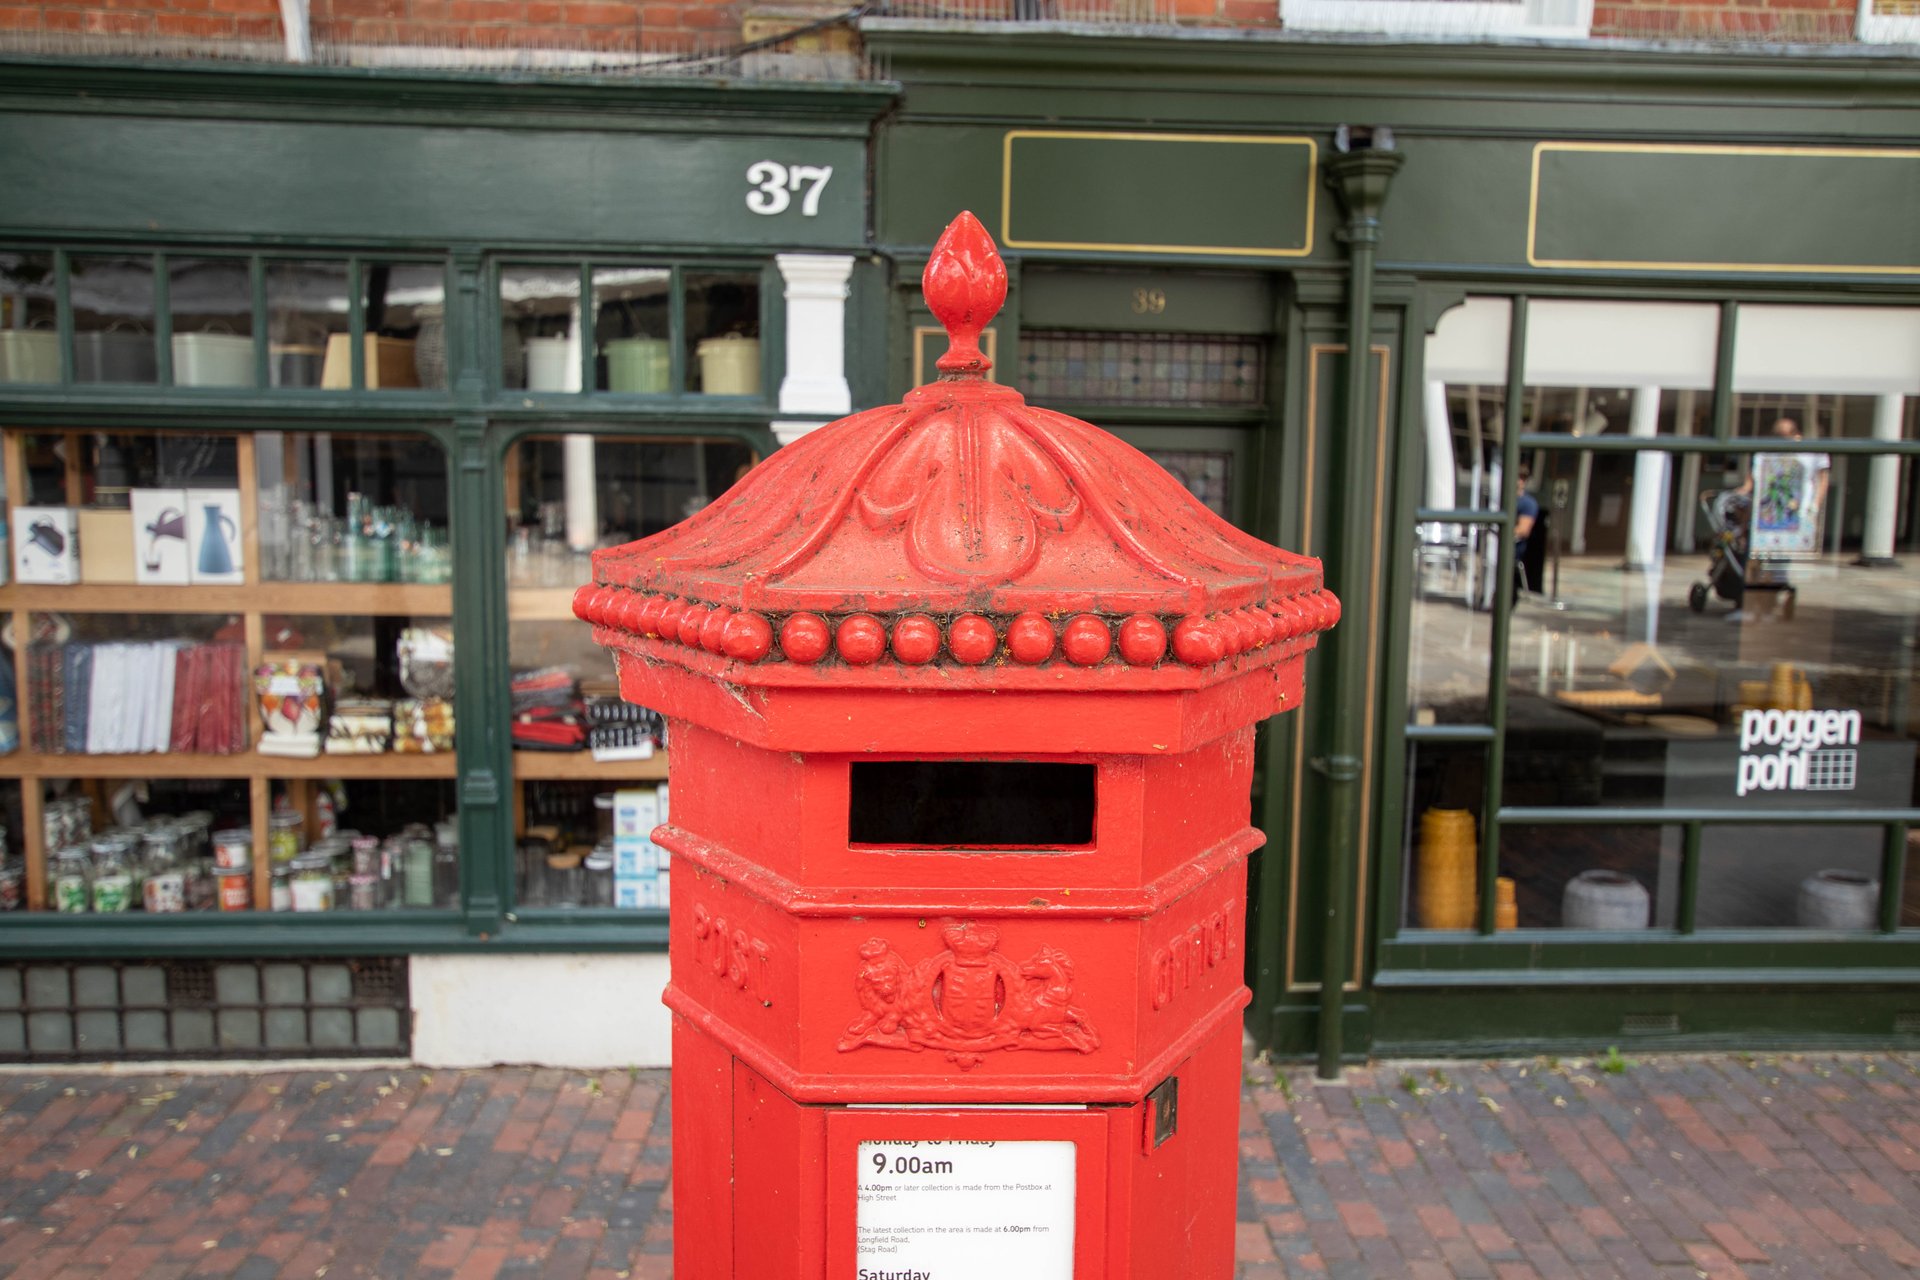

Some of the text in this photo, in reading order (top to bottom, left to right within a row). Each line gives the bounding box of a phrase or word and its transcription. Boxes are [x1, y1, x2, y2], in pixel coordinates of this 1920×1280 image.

[745, 160, 833, 216] 37
[1130, 287, 1166, 315] 39
[1740, 709, 1861, 751] poggen
[1736, 749, 1808, 797] pohl
[872, 1153, 953, 1174] 9.00am
[864, 1184, 893, 1193] 4.00pm
[903, 1183, 919, 1191] later
[921, 1183, 954, 1191] collection
[954, 1183, 960, 1191] is
[962, 1183, 982, 1191] made
[984, 1183, 1000, 1191] from
[1002, 1183, 1014, 1191] the
[1015, 1183, 1043, 1191] Postbox
[857, 1193, 897, 1203] High Street
[927, 1225, 934, 1233] in
[935, 1225, 947, 1233] the
[965, 1225, 971, 1233] is
[973, 1225, 992, 1233] made
[1003, 1225, 1031, 1234] 6.00pm
[1032, 1225, 1050, 1233] from
[857, 1236, 889, 1244] Longfield
[857, 1245, 898, 1254] (Stag Road)
[859, 1268, 931, 1280] Saturday
